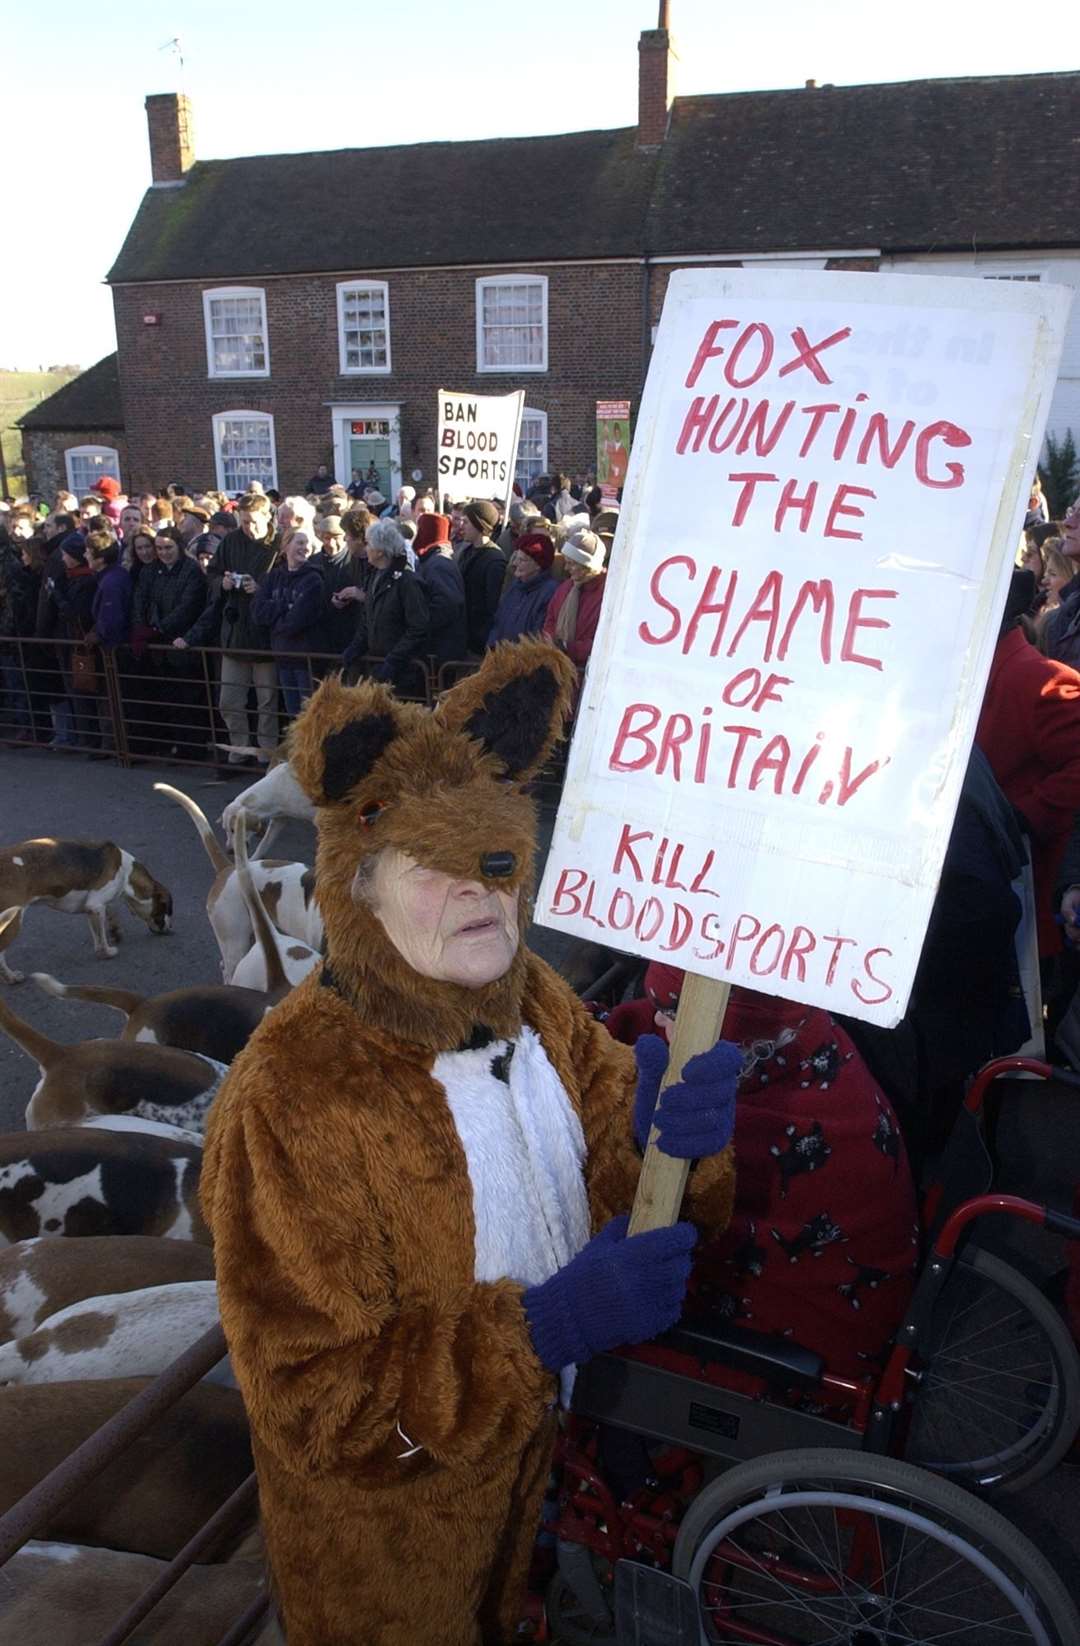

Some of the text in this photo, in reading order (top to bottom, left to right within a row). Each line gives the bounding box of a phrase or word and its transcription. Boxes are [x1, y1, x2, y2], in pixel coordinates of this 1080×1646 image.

[686, 319, 850, 389] FOX
[441, 428, 498, 452] BLOOD
[444, 402, 477, 423] BAN
[439, 455, 507, 481] SPORTS
[729, 472, 875, 540] THE
[639, 555, 898, 671] SHAME
[722, 667, 792, 713] OF
[612, 825, 720, 897] KILL
[552, 868, 894, 1006] BLOODSPORTS
